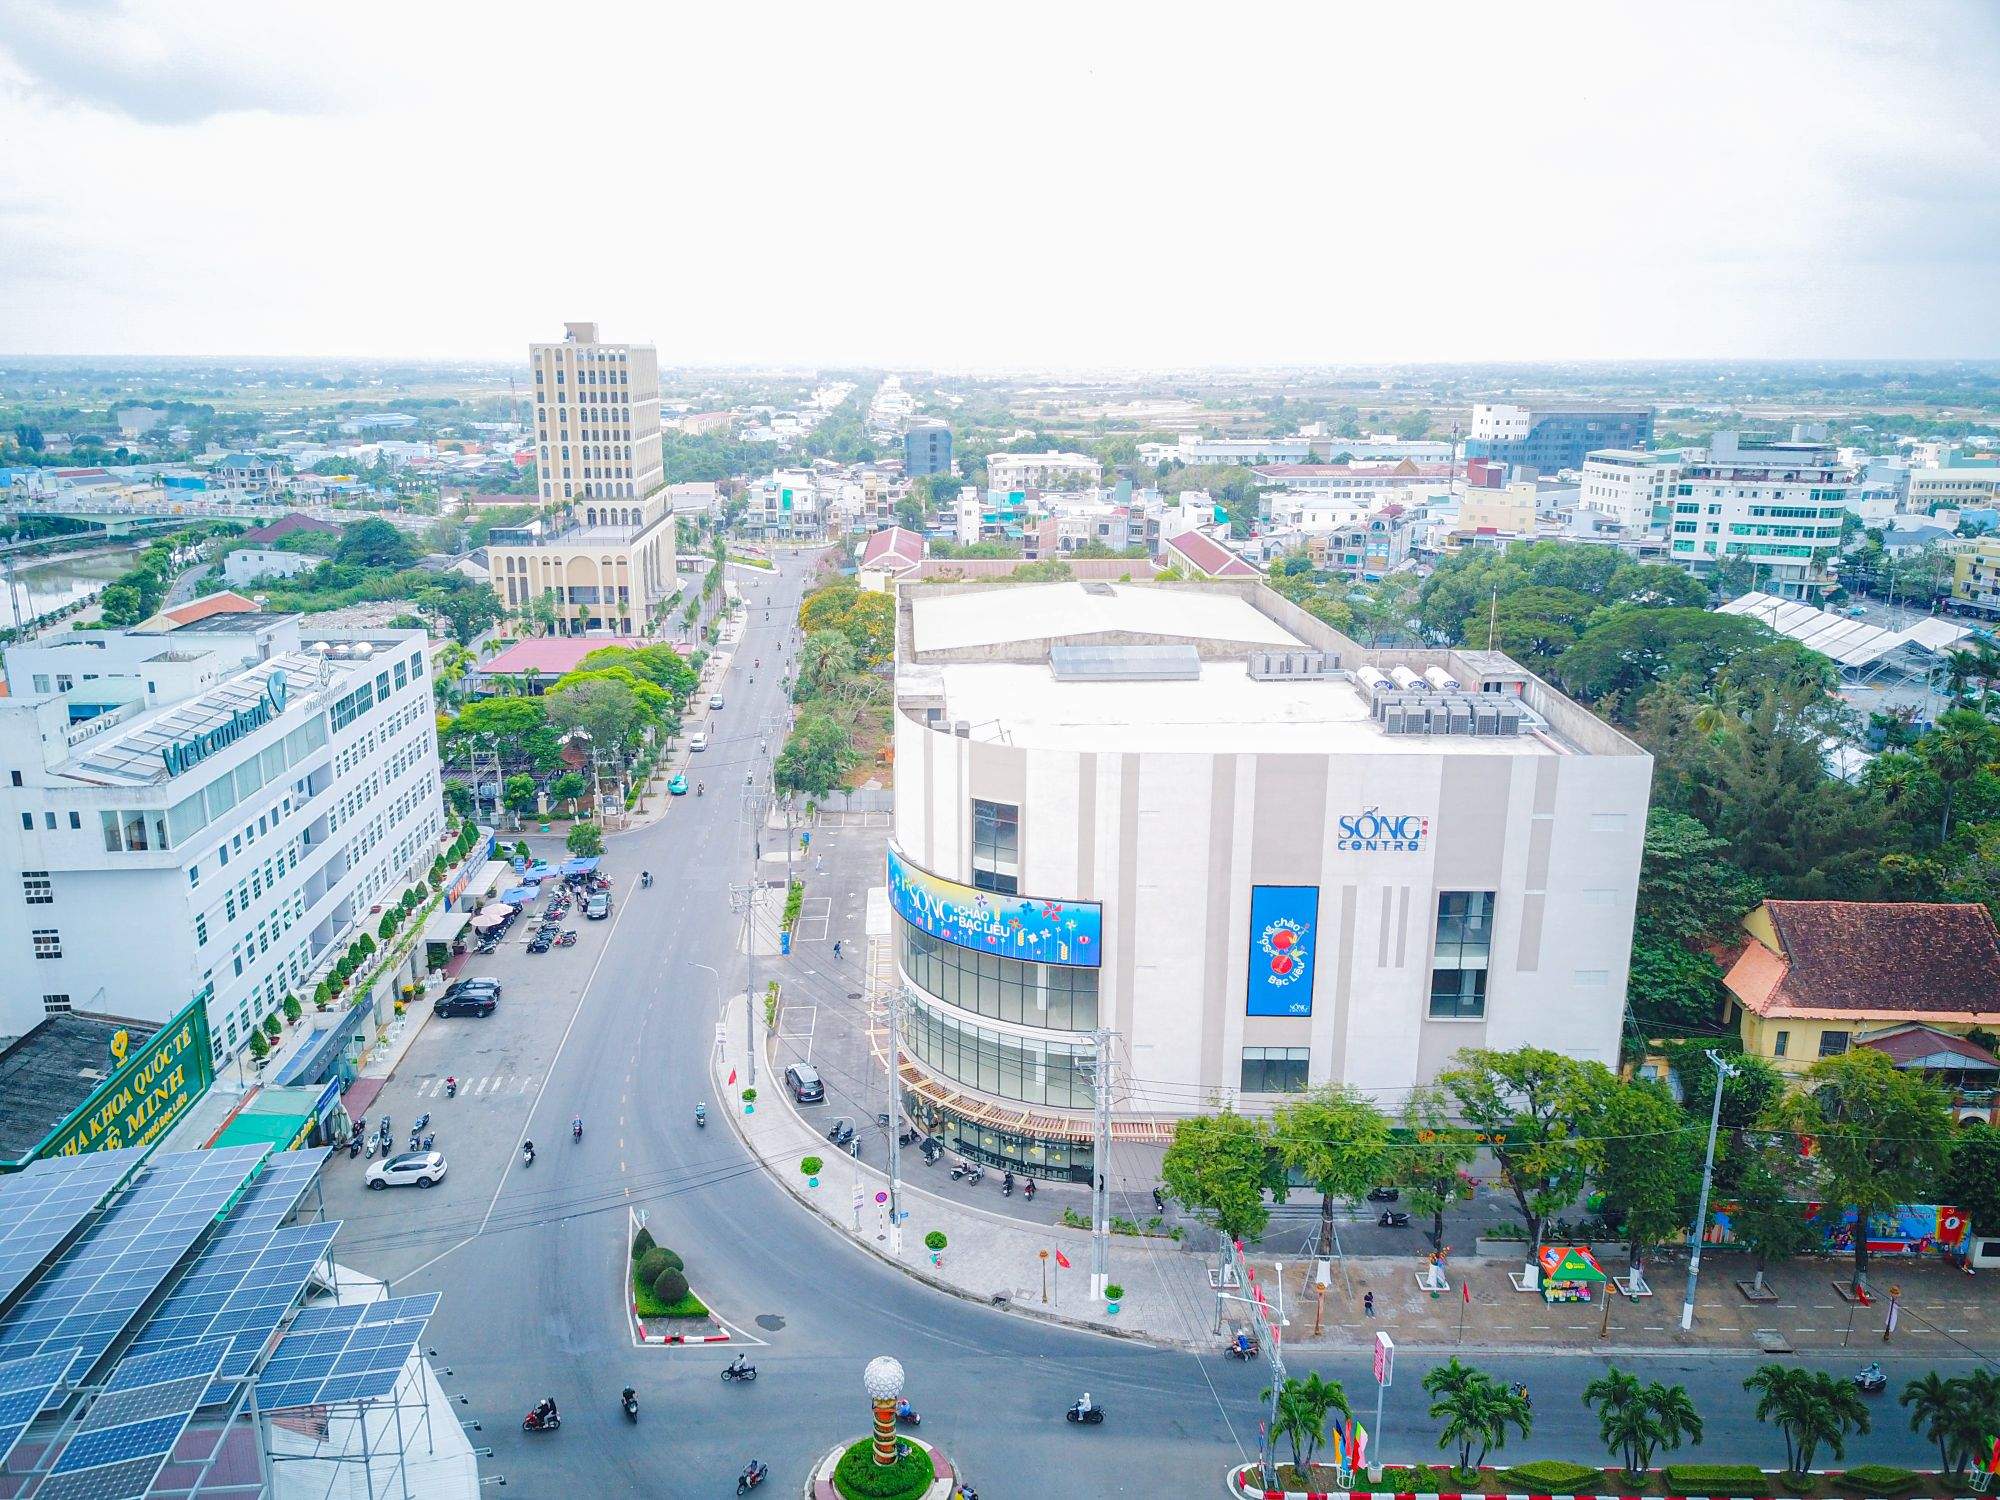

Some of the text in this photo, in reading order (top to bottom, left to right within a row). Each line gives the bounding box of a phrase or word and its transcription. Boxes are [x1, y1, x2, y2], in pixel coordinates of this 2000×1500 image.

[162, 694, 272, 777] Vietcombank
[984, 922, 1010, 937] LIÊU
[89, 1087, 133, 1139] KHOA
[134, 1047, 173, 1095] QUỐC
[172, 1022, 191, 1055] TẾ
[125, 1064, 185, 1138] MINH
